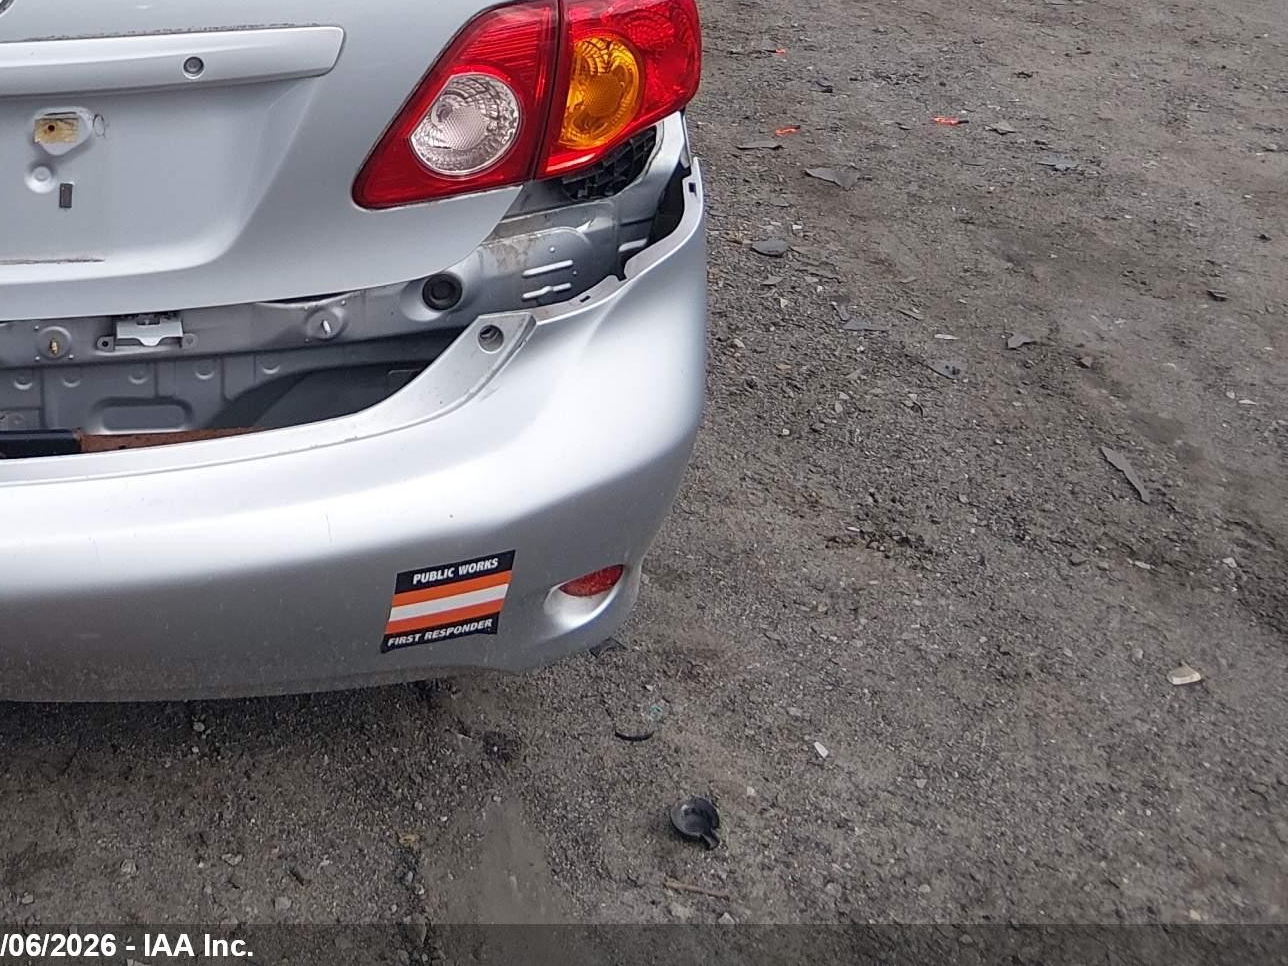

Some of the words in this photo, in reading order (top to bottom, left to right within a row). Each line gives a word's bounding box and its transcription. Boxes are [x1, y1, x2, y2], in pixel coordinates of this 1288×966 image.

[412, 567, 455, 585] PUBLIC
[458, 557, 499, 576] WORKS
[387, 633, 422, 647] FIRST
[424, 618, 493, 640] RESPONDER
